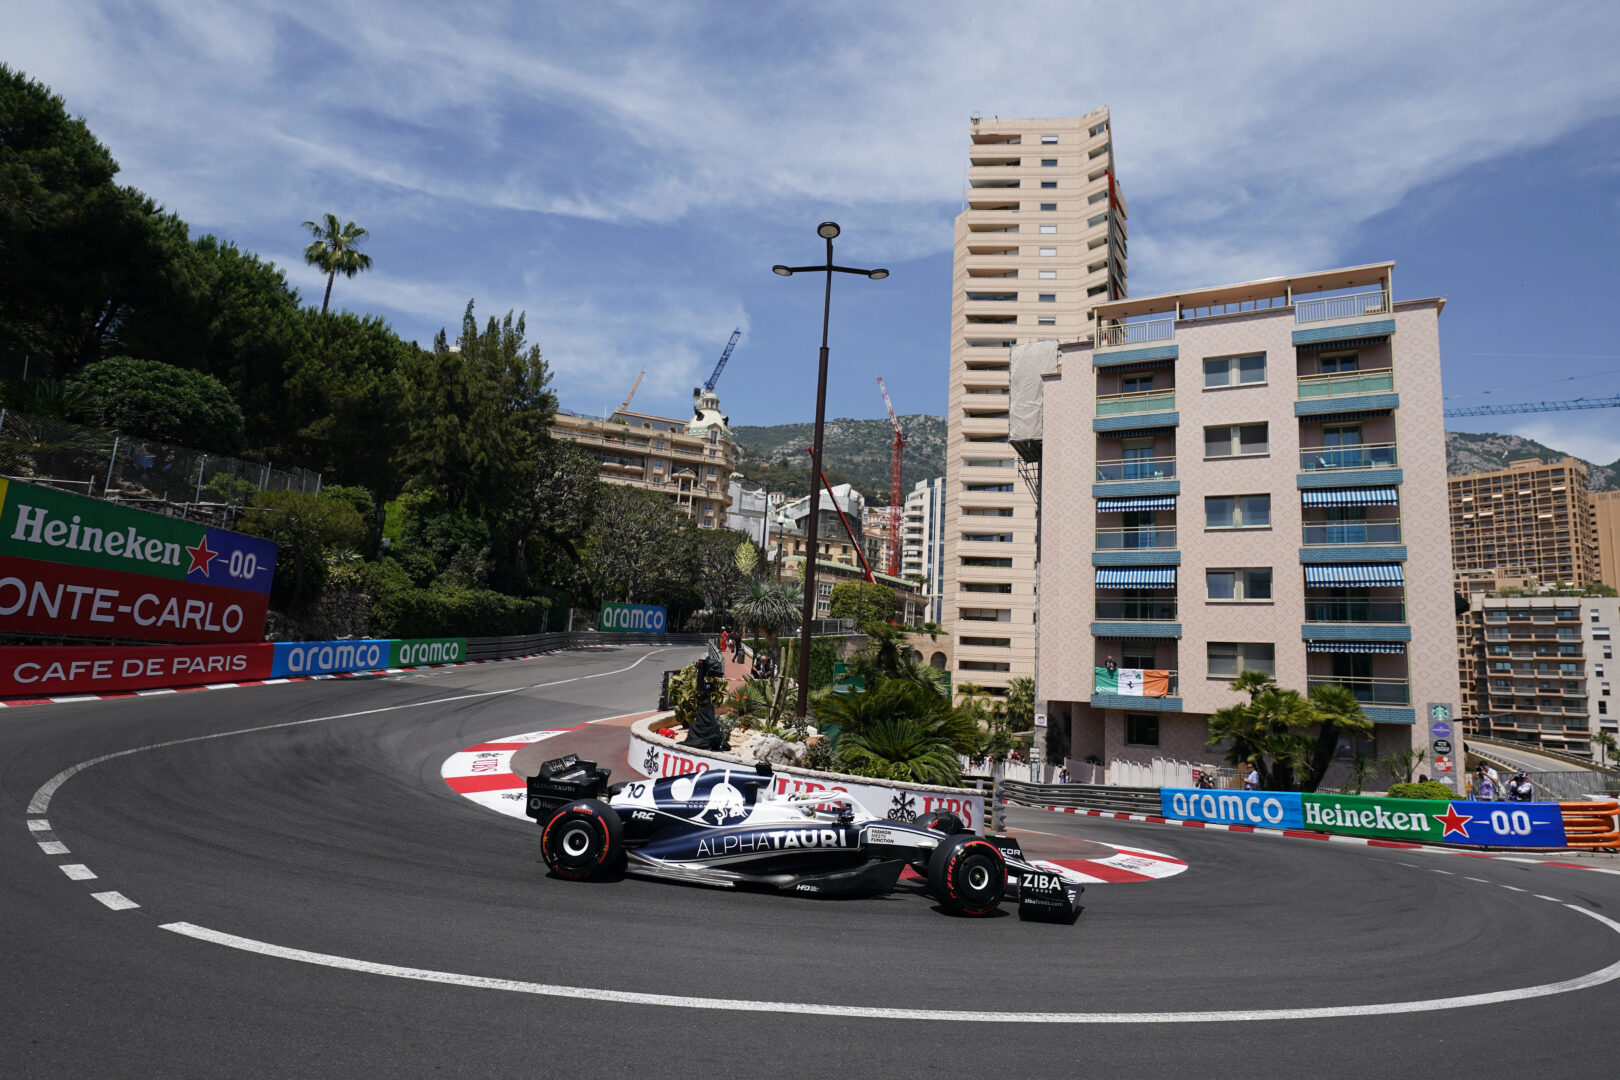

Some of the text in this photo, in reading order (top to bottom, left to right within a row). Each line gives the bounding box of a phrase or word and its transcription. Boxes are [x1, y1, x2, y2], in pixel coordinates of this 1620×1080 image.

[11, 504, 181, 566] Heineken
[229, 550, 256, 579] 0.0
[0, 577, 243, 633] ONTE-CARLO
[603, 606, 664, 630] aramco
[288, 644, 380, 672] aramco
[400, 642, 459, 665] aramco
[13, 654, 248, 683] CAFE DE PARIS
[628, 783, 646, 799] 10
[632, 811, 655, 820] HRC
[1173, 793, 1283, 824] aramco
[1305, 803, 1430, 832] Heineken
[1492, 810, 1531, 836] 0.0
[697, 829, 846, 858] ALPHATAURI
[1023, 873, 1061, 890] ZIBA
[1024, 898, 1064, 907] zibafoods.com
